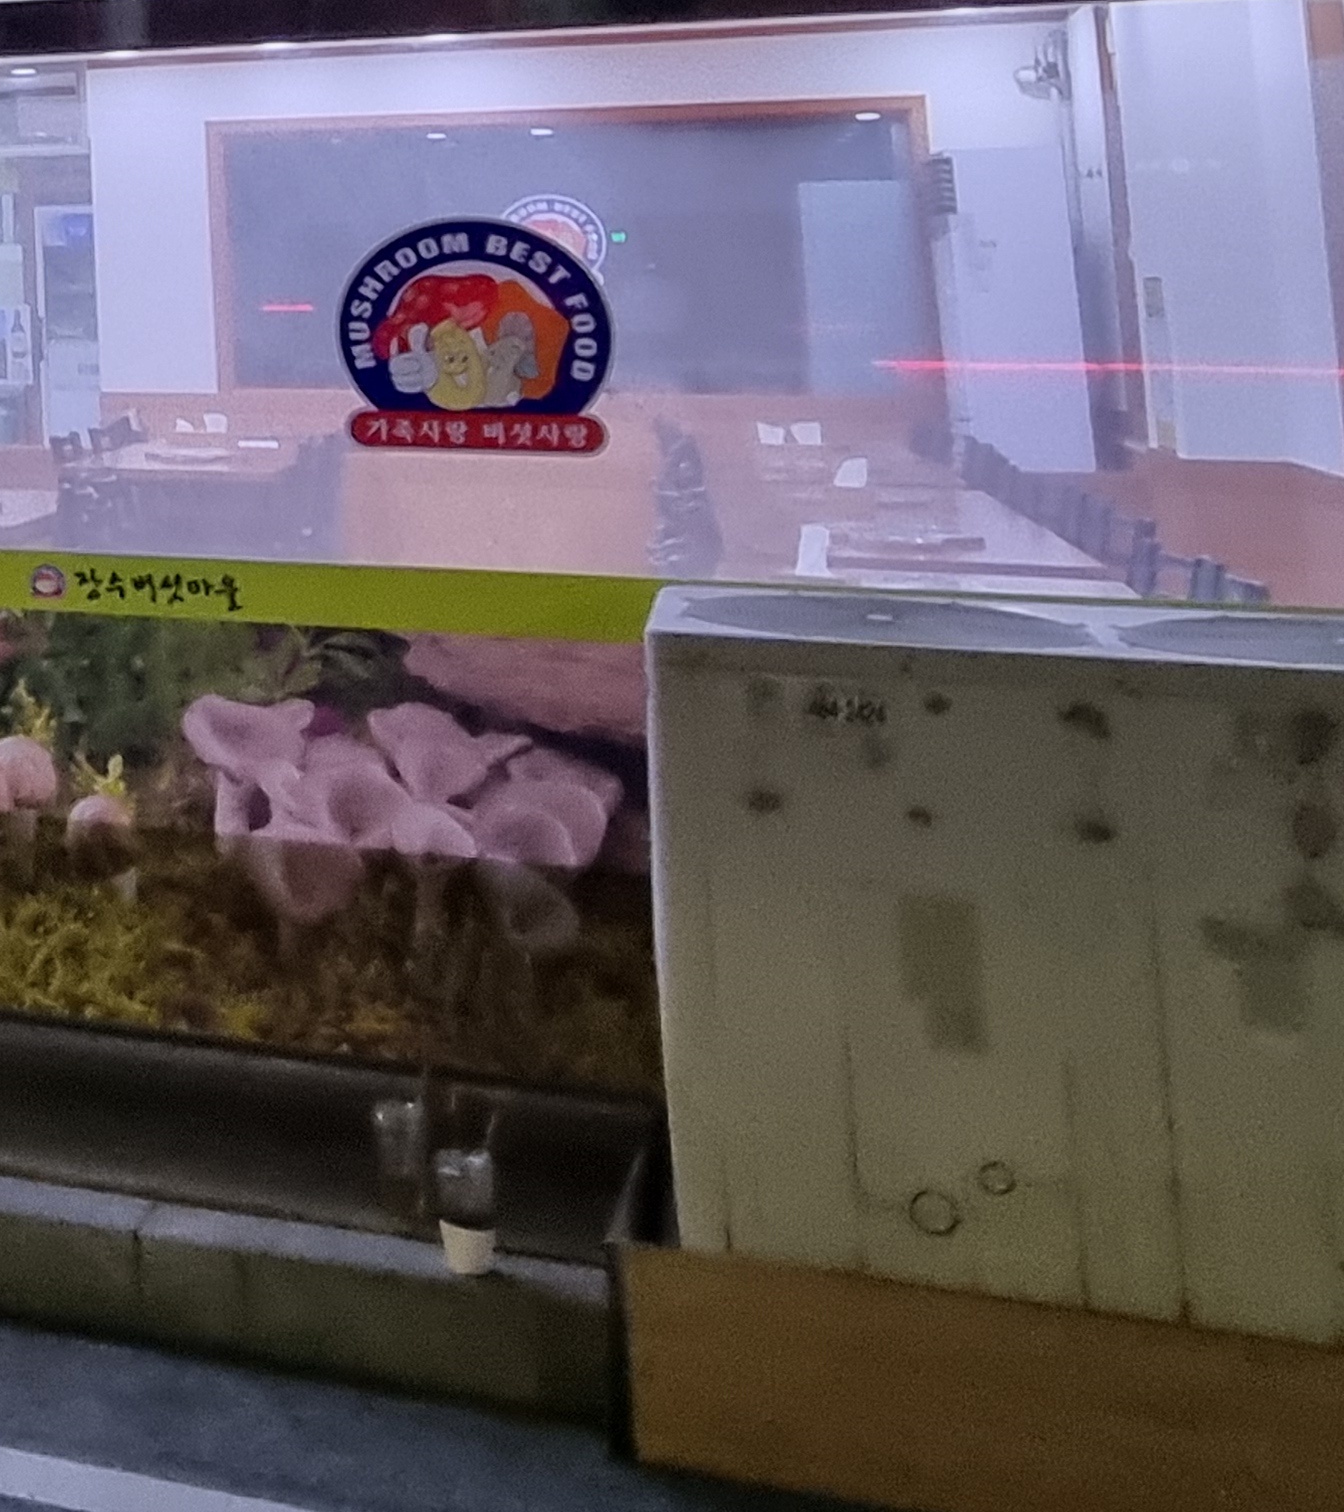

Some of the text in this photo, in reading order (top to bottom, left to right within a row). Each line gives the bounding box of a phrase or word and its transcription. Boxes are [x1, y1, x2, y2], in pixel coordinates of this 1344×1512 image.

[348, 232, 598, 382] MUSHROOM BEST FOOD
